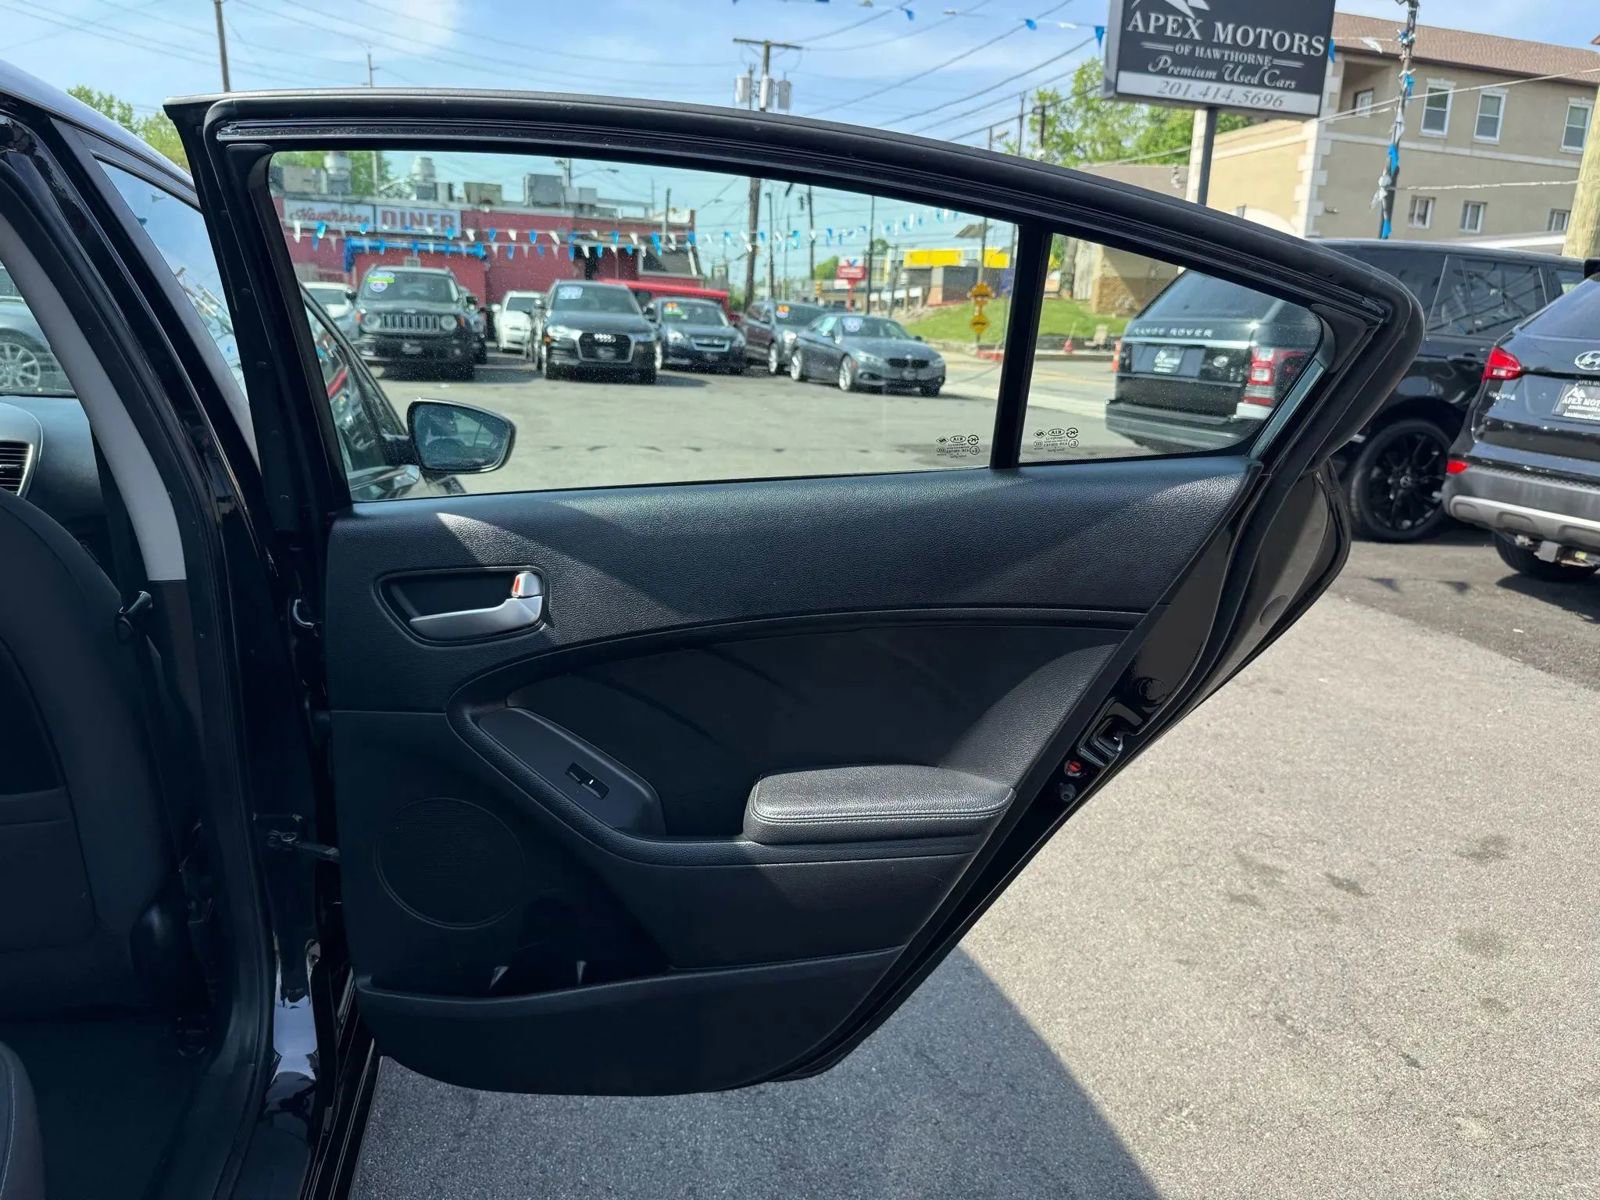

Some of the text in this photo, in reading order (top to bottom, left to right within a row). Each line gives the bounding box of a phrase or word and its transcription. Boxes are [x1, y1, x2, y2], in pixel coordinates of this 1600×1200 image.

[1126, 10, 1326, 57] APEX MOTORS
[1175, 43, 1273, 67] OF HAWTHORNE
[1147, 55, 1297, 89] Premium Used Cars
[1157, 80, 1284, 109] 201.414.5696
[382, 210, 455, 229] DINER
[1169, 327, 1213, 338] ROVER
